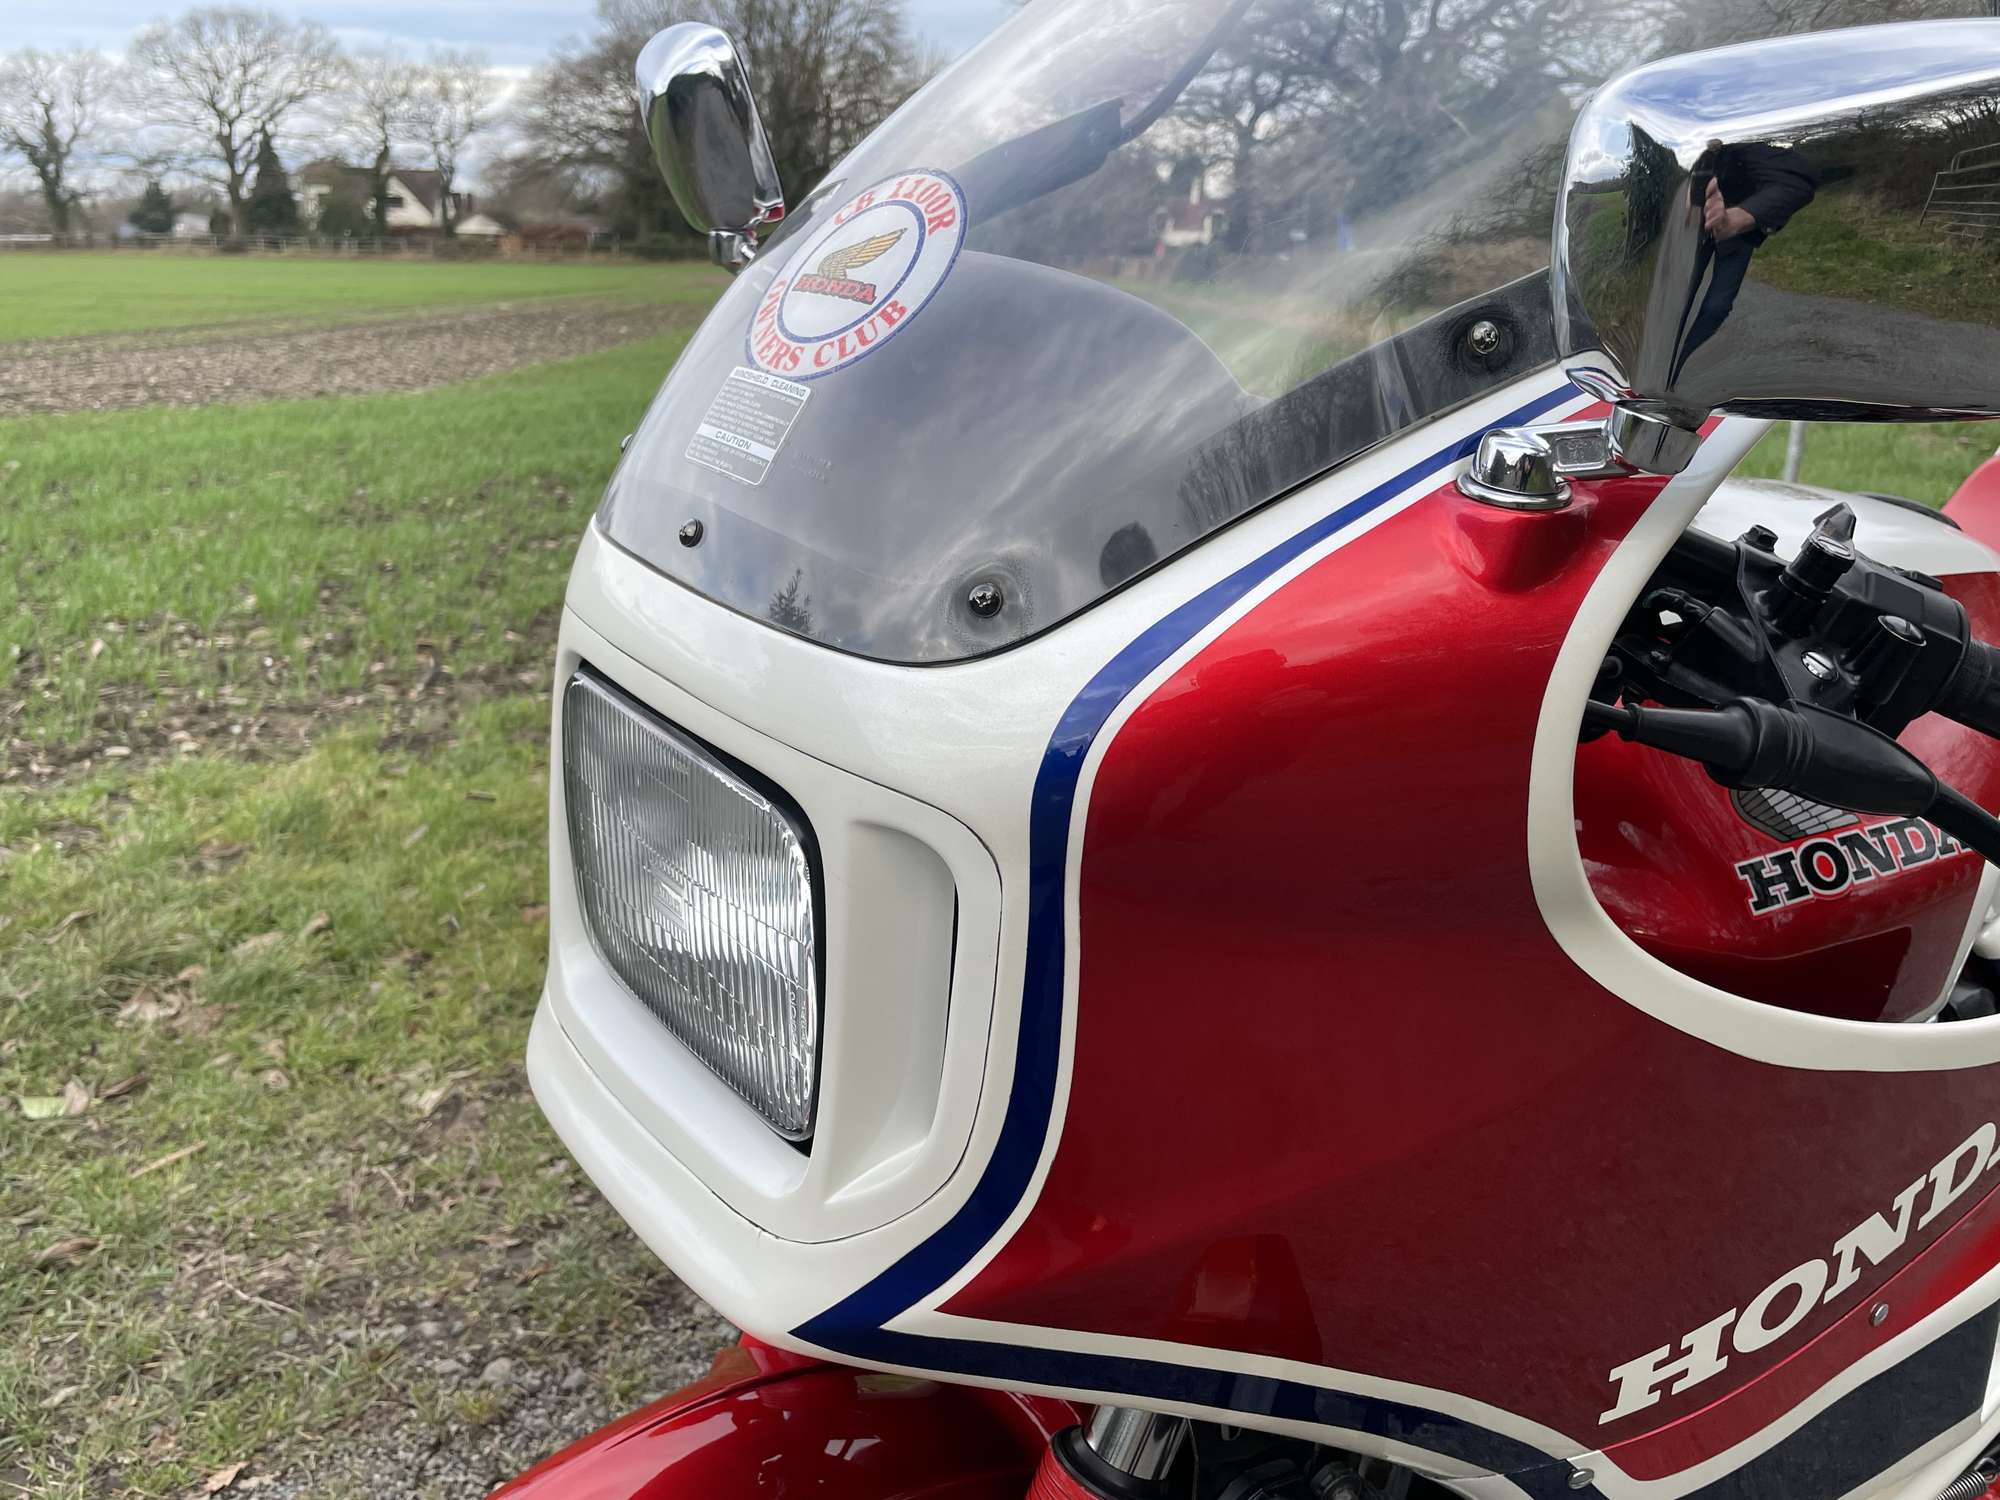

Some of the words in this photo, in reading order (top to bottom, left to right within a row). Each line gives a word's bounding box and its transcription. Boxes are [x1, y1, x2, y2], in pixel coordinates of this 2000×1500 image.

[834, 191, 875, 225] CB
[889, 176, 956, 237] 1100R
[792, 273, 877, 306] HONDA
[813, 299, 908, 369] CLUB
[714, 430, 752, 450] CAUTION
[1598, 1122, 2000, 1425] HOND
